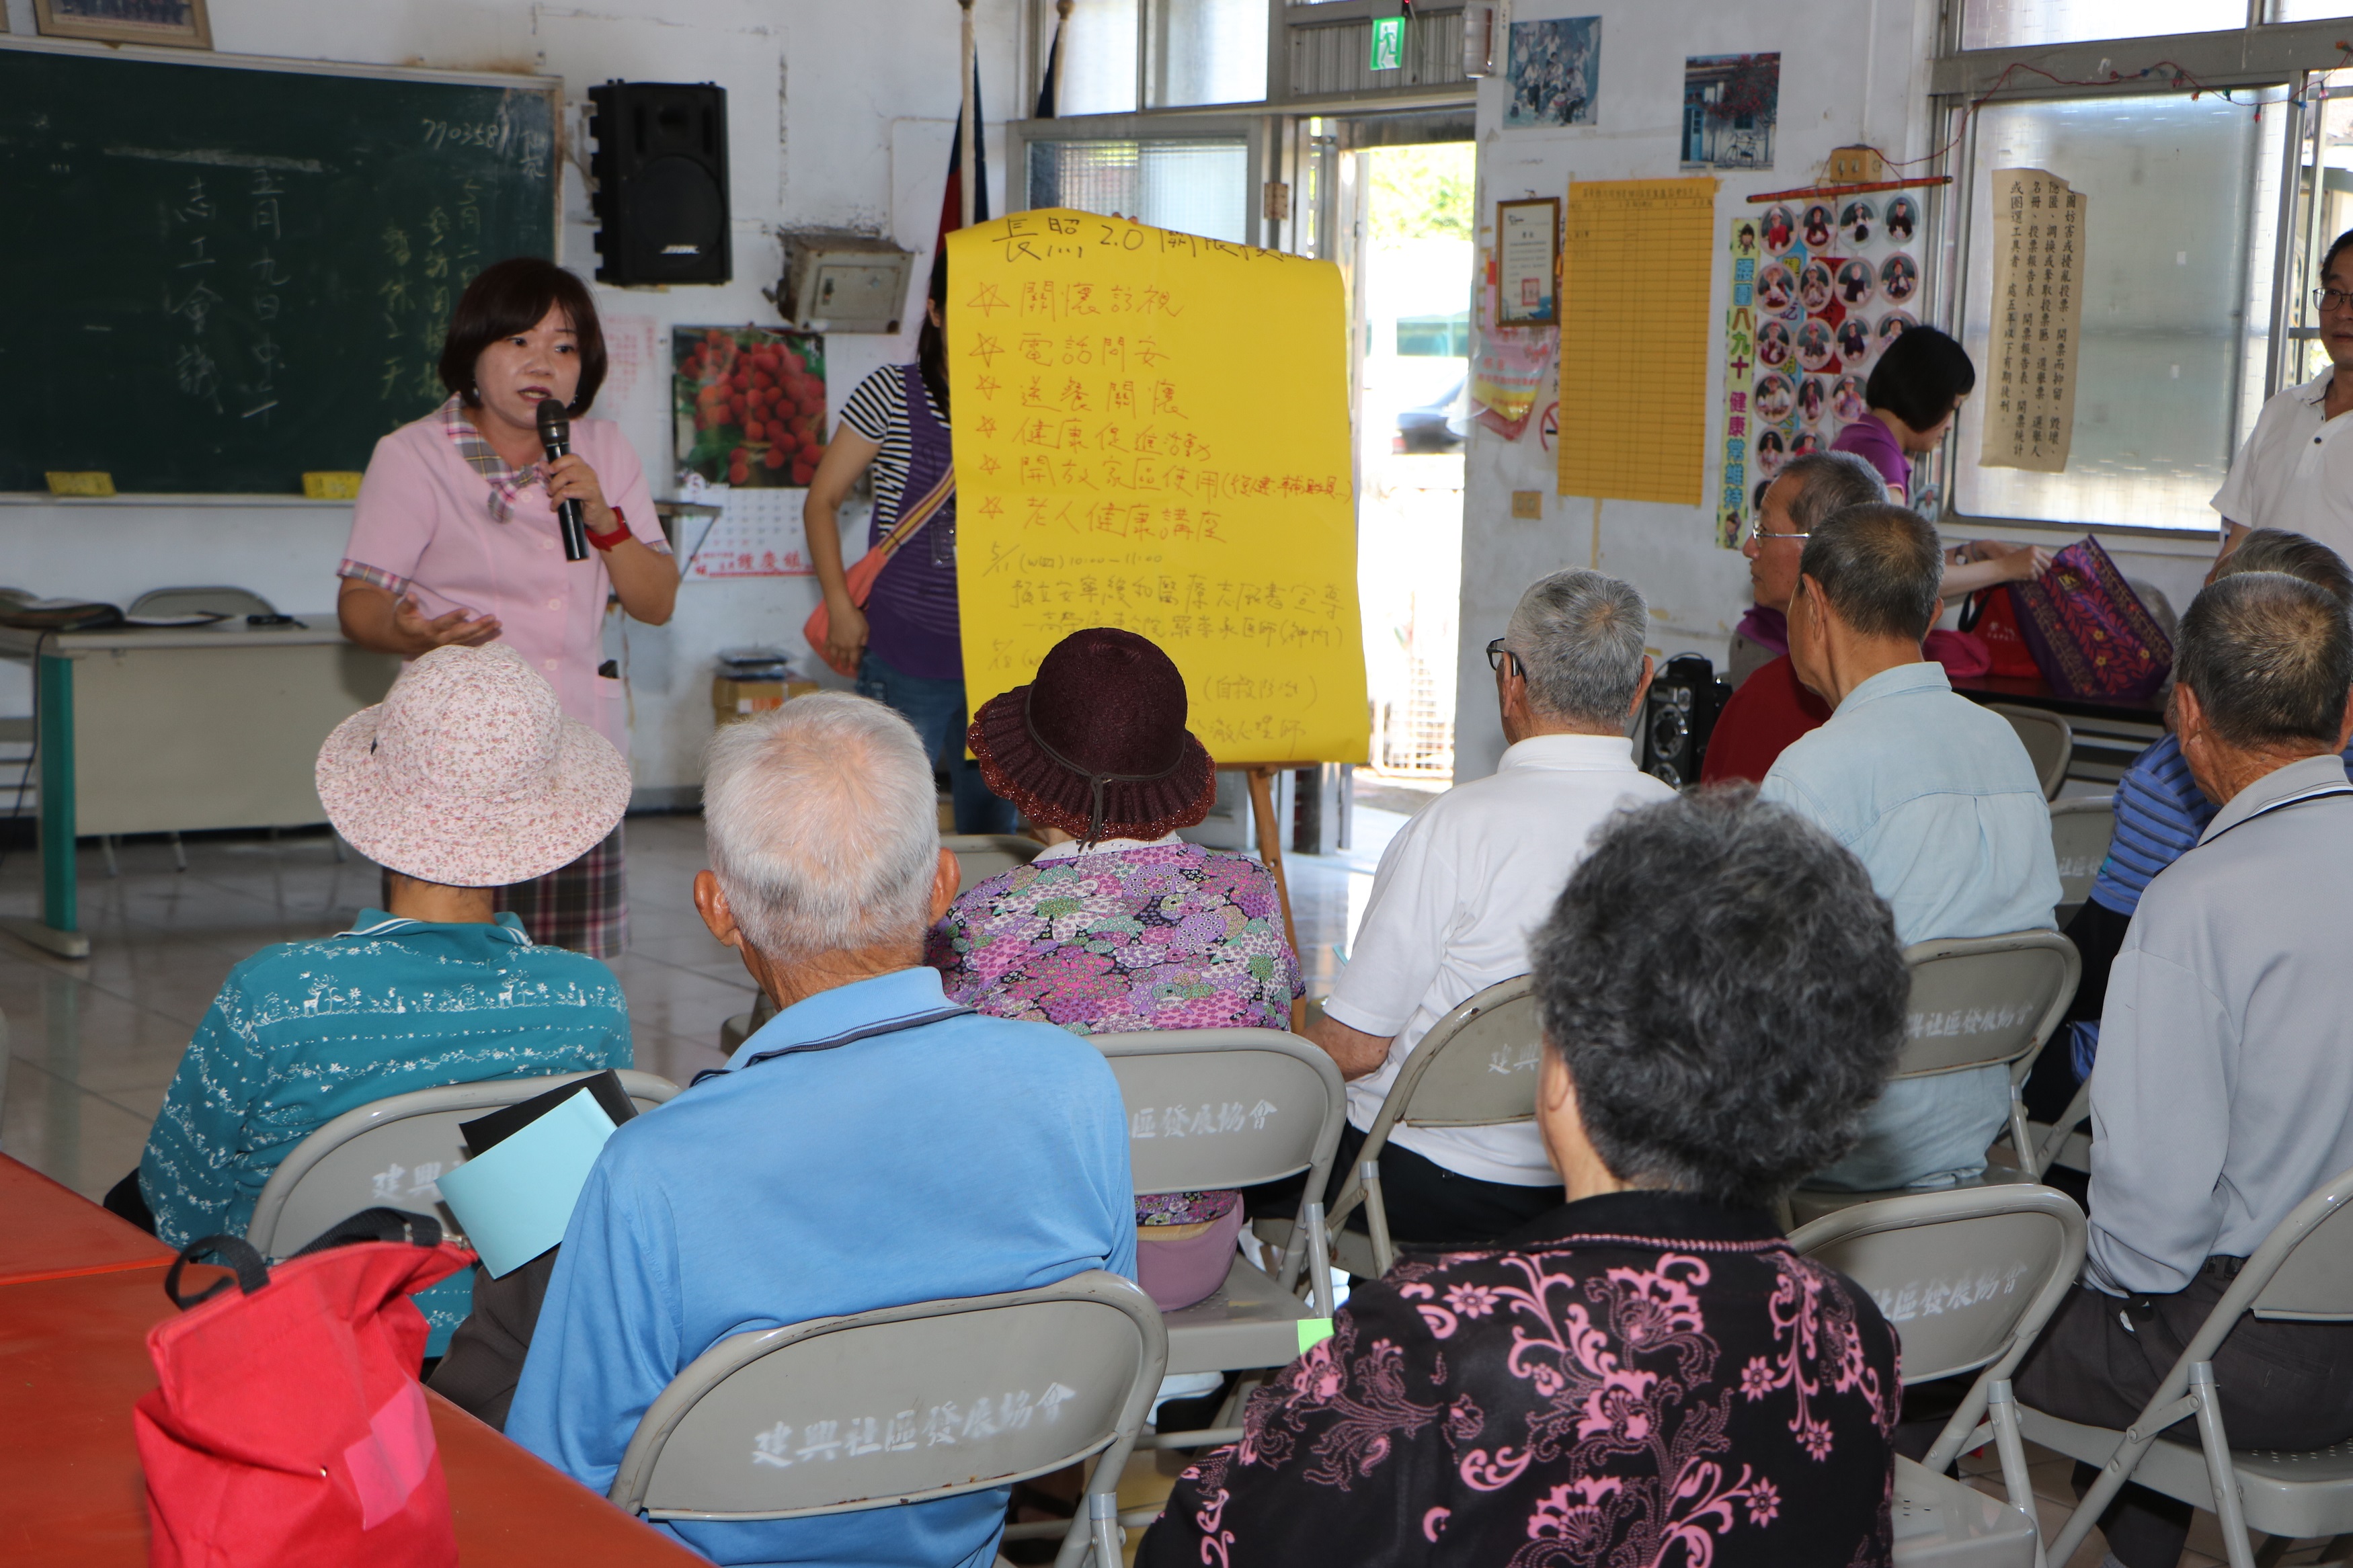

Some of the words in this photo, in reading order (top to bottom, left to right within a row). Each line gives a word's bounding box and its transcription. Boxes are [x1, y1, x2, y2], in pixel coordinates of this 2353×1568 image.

[1019, 281, 1185, 323] 關懷訪視
[2048, 190, 2077, 454] 圖妨害或擾亂投票、開票而抑留、毀壞、
[1023, 496, 1226, 544] 老人健康講座
[752, 1382, 1076, 1468] 建興社區發展協會
